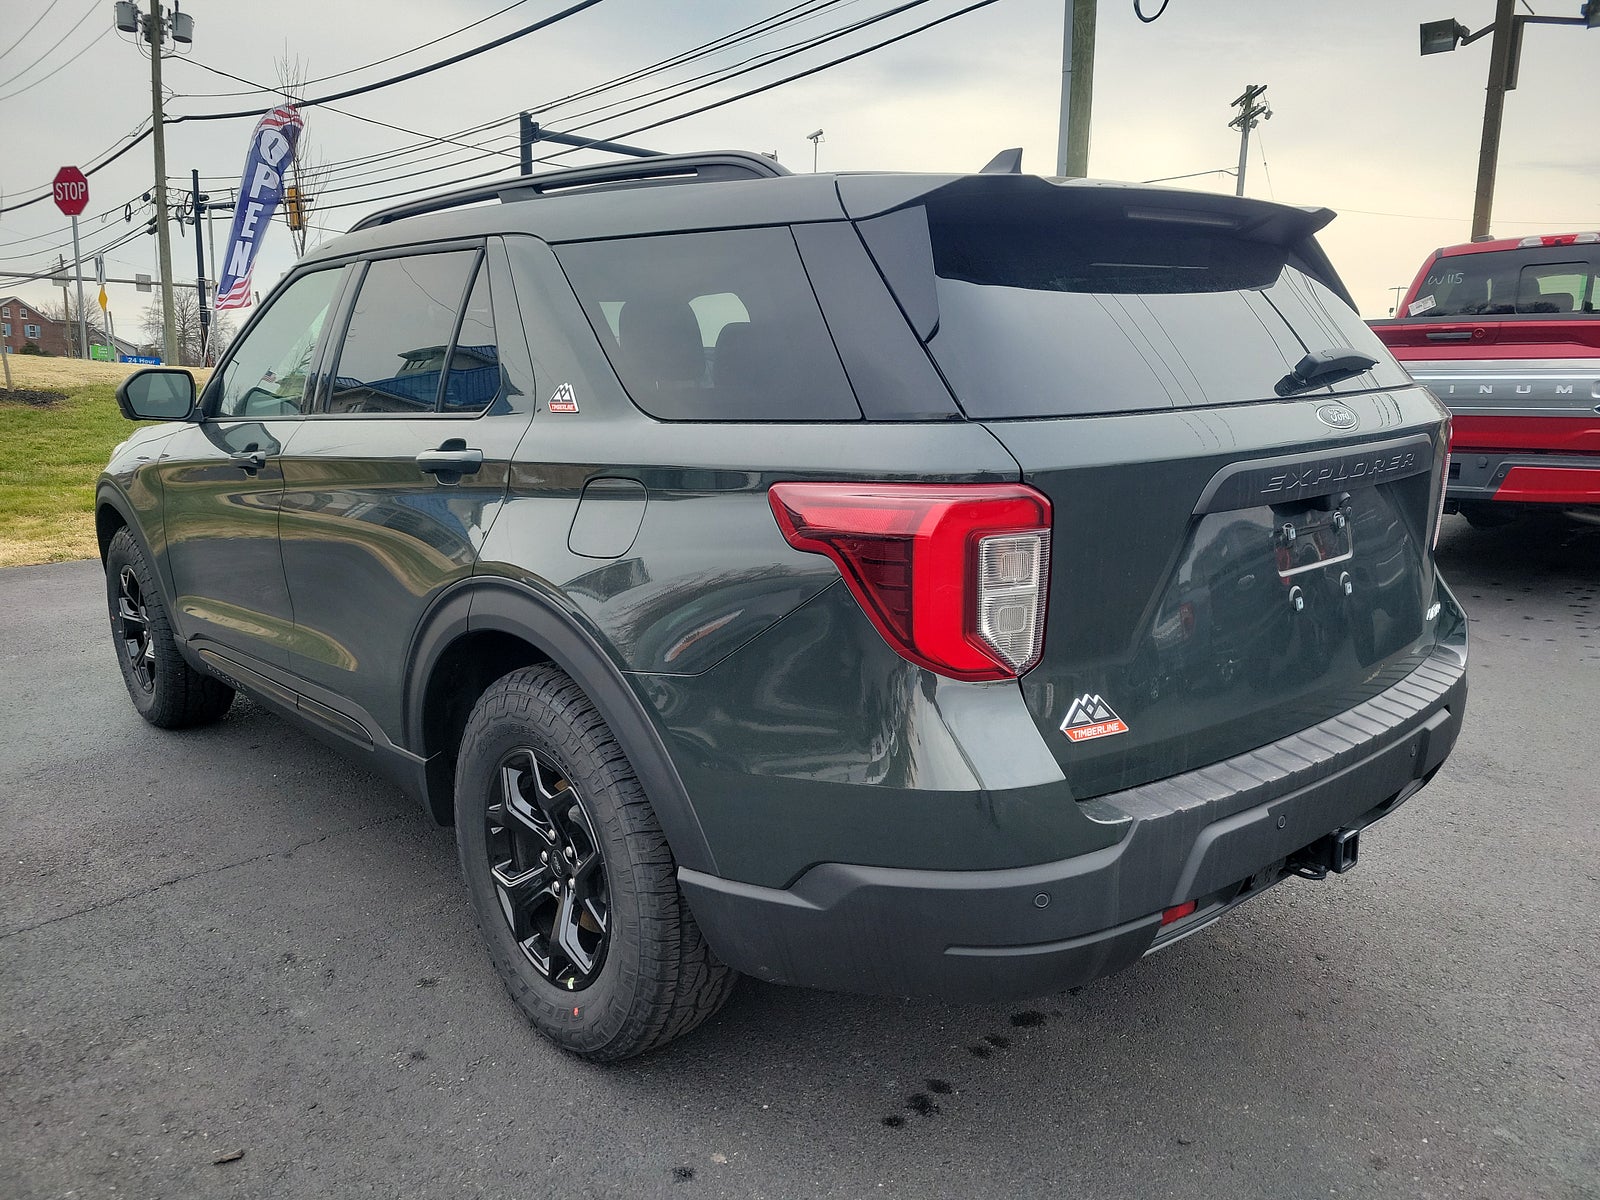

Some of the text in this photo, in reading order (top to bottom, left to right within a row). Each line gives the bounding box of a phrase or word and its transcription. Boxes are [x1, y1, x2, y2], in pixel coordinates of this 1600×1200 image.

[55, 181, 87, 201] STOP
[228, 129, 290, 278] OPEN
[1327, 407, 1351, 422] Ford
[1260, 453, 1416, 494] EXPLORER
[1072, 722, 1120, 740] TIMBERLINE
